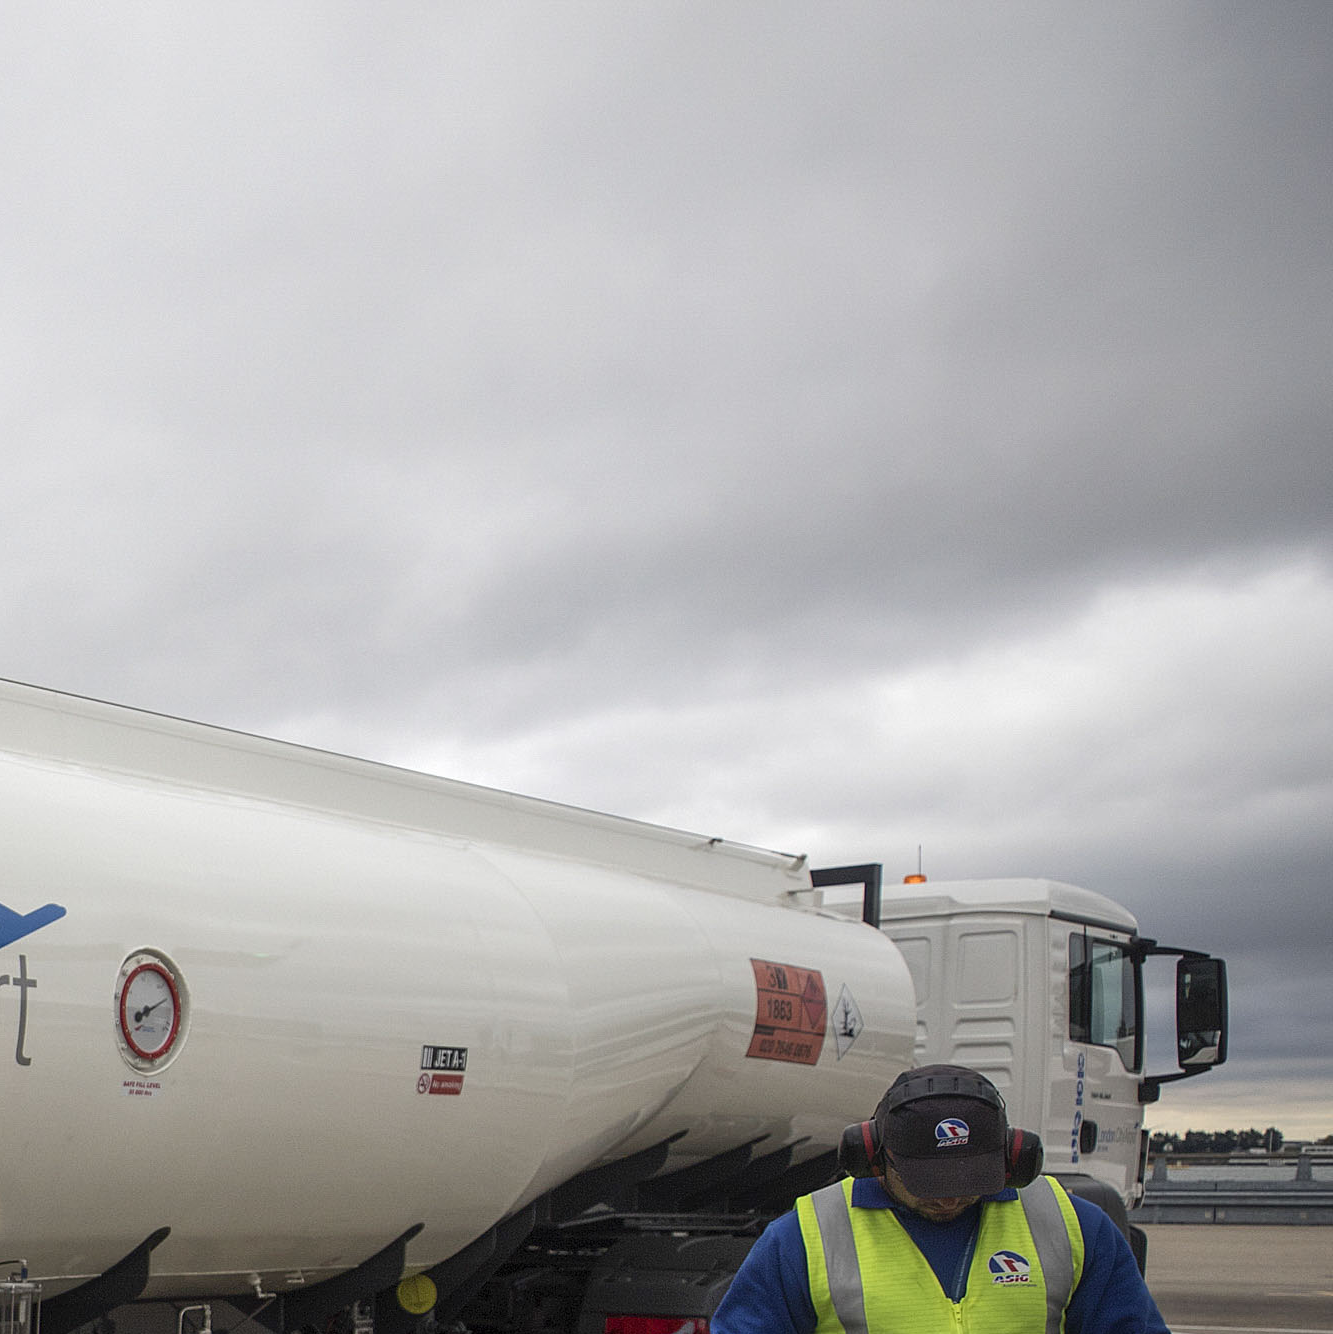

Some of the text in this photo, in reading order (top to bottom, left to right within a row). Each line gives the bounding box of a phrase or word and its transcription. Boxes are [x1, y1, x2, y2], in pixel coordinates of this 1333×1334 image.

[435, 1049, 467, 1068] JET A-1
[994, 1274, 1029, 1283] ASIG
